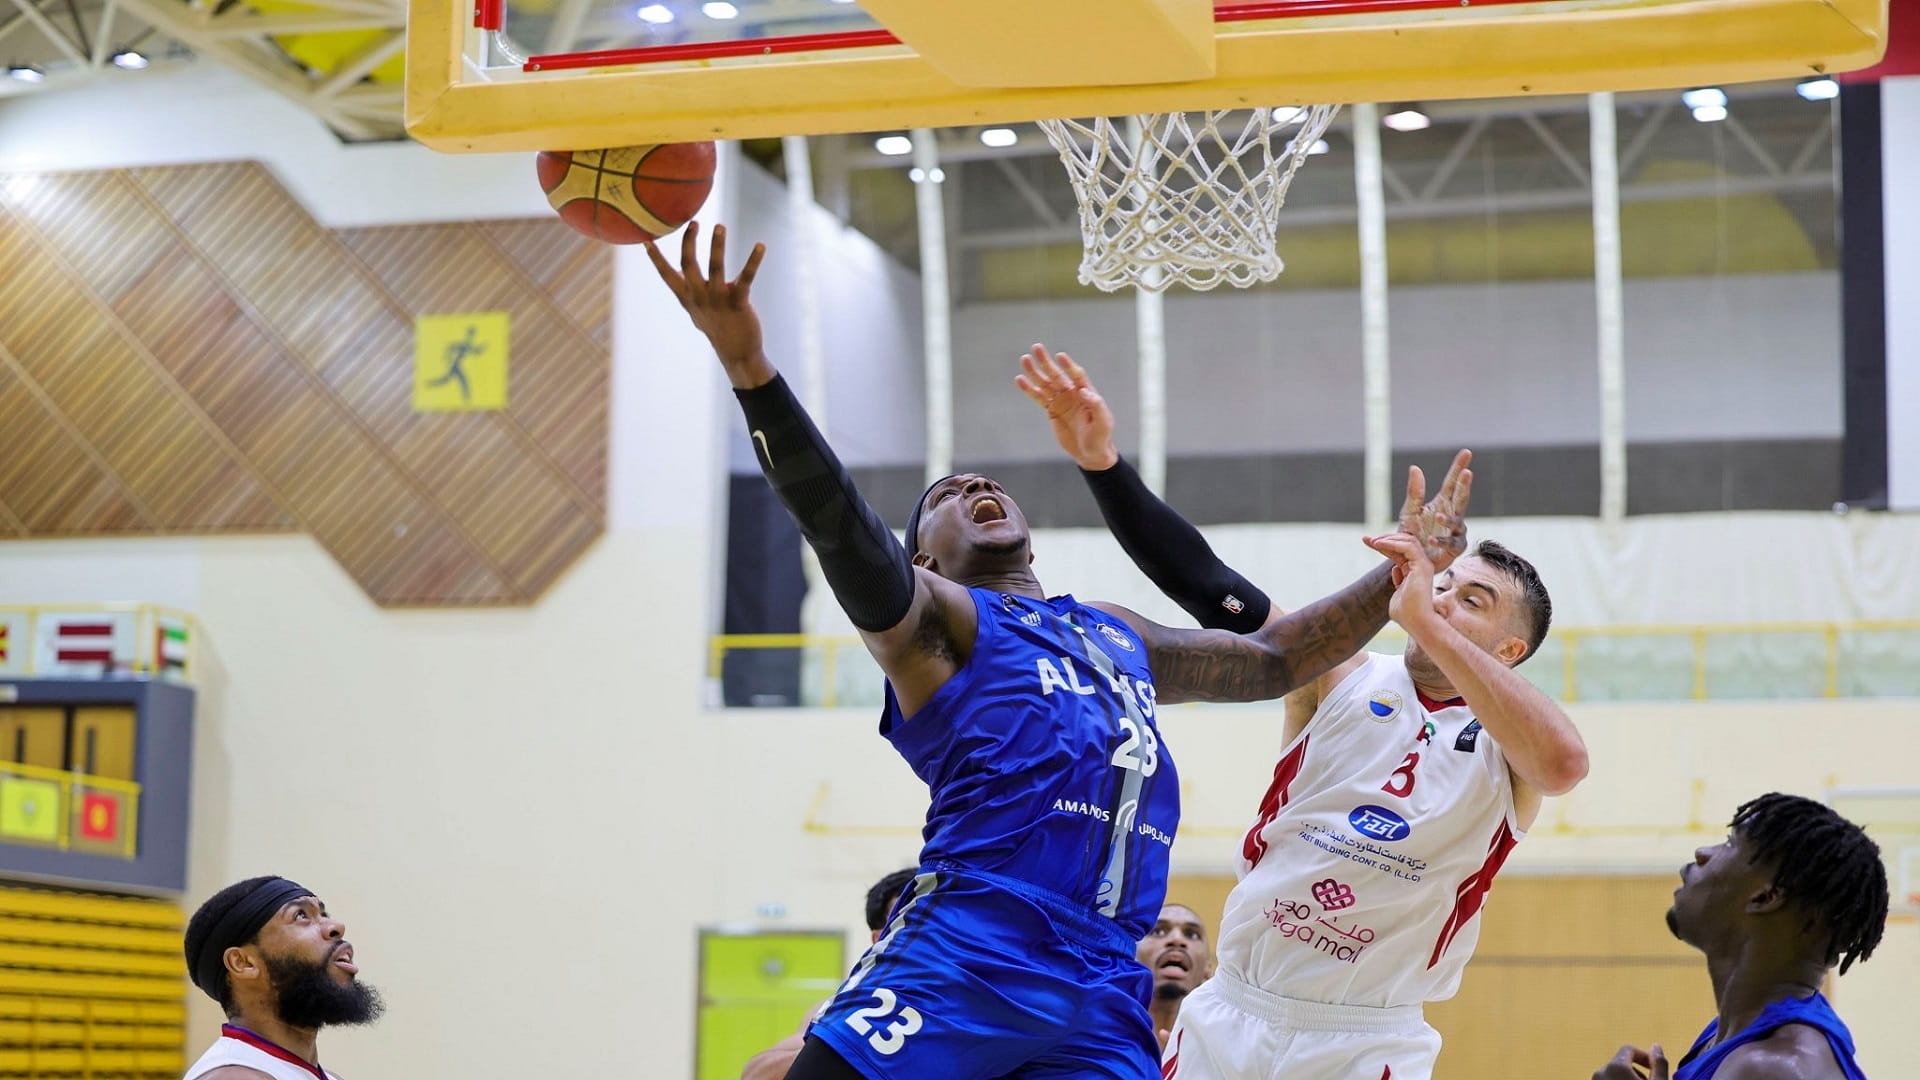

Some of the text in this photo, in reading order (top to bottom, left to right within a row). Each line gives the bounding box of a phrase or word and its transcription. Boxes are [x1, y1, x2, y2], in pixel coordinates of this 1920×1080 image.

[1036, 656, 1096, 695] AL
[1111, 717, 1158, 778] 23
[1052, 798, 1111, 822] AMANOS
[1297, 830, 1315, 844] FAST
[1313, 838, 1351, 859] BUILDING
[1352, 854, 1378, 869] CONT.
[1379, 863, 1393, 873] CO.
[844, 987, 924, 1056] 23
